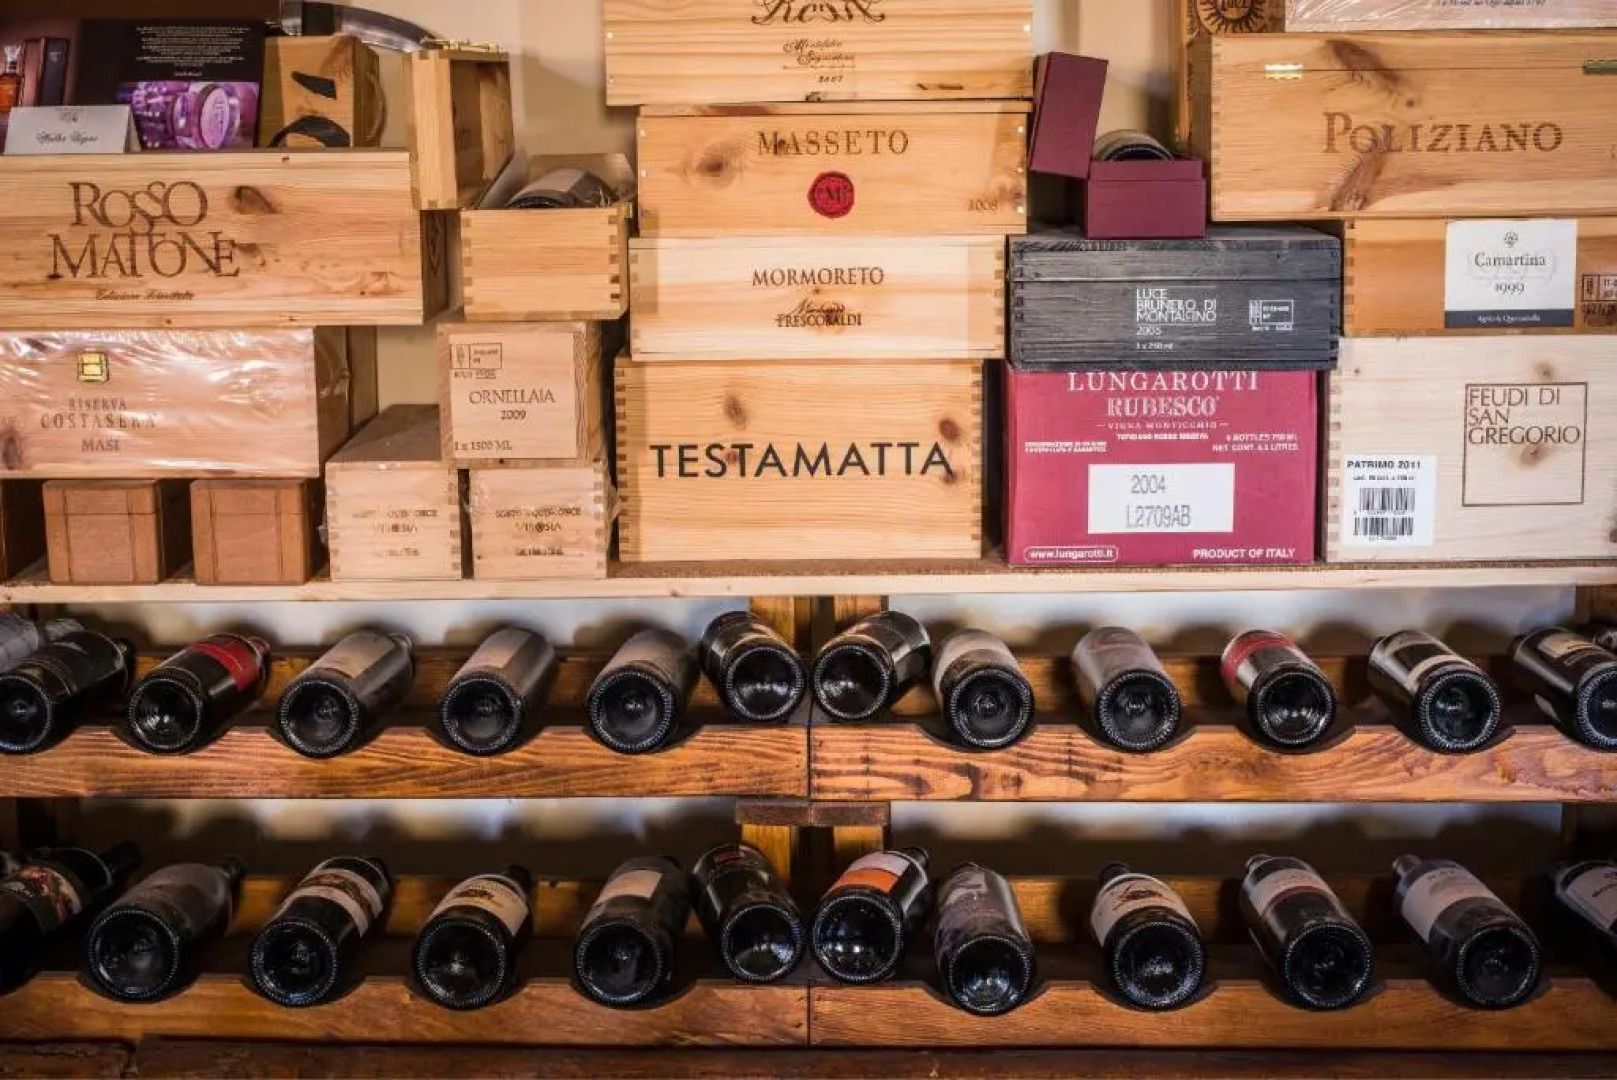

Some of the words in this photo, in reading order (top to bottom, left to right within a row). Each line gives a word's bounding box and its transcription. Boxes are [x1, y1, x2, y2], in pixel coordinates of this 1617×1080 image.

[1322, 111, 1563, 153] POLIZIANO
[757, 130, 909, 155] MASSETO
[68, 181, 208, 234] ROSSO
[1474, 251, 1547, 268] Camartina
[752, 267, 884, 286] MORMORETO
[1136, 288, 1168, 299] LUCE
[1204, 299, 1217, 311] DI
[1136, 310, 1217, 322] MONTALCINO
[1067, 371, 1258, 391] LUNGAROTTI
[68, 397, 127, 411] RISERVA
[468, 388, 556, 405] ORNELLAIA
[1468, 387, 1528, 406] FEUDI
[1539, 387, 1561, 405] DI
[500, 409, 527, 420] 2009
[1107, 397, 1216, 416] RUBESCO
[1467, 407, 1510, 426] SAN
[1468, 425, 1581, 444] GREGORIO
[81, 438, 121, 452] MASI
[471, 441, 494, 451] 1500
[649, 442, 954, 478] TESTAMATTA
[1346, 460, 1395, 469] PATRIMO
[1398, 460, 1421, 469] 2011
[1130, 474, 1165, 494] 2004
[1125, 504, 1191, 528] L2709AB
[1029, 549, 1113, 559] www.lungarotti.it
[1193, 549, 1246, 559] PRODUCT
[1248, 549, 1262, 559] OF
[1265, 548, 1296, 559] ITALY
